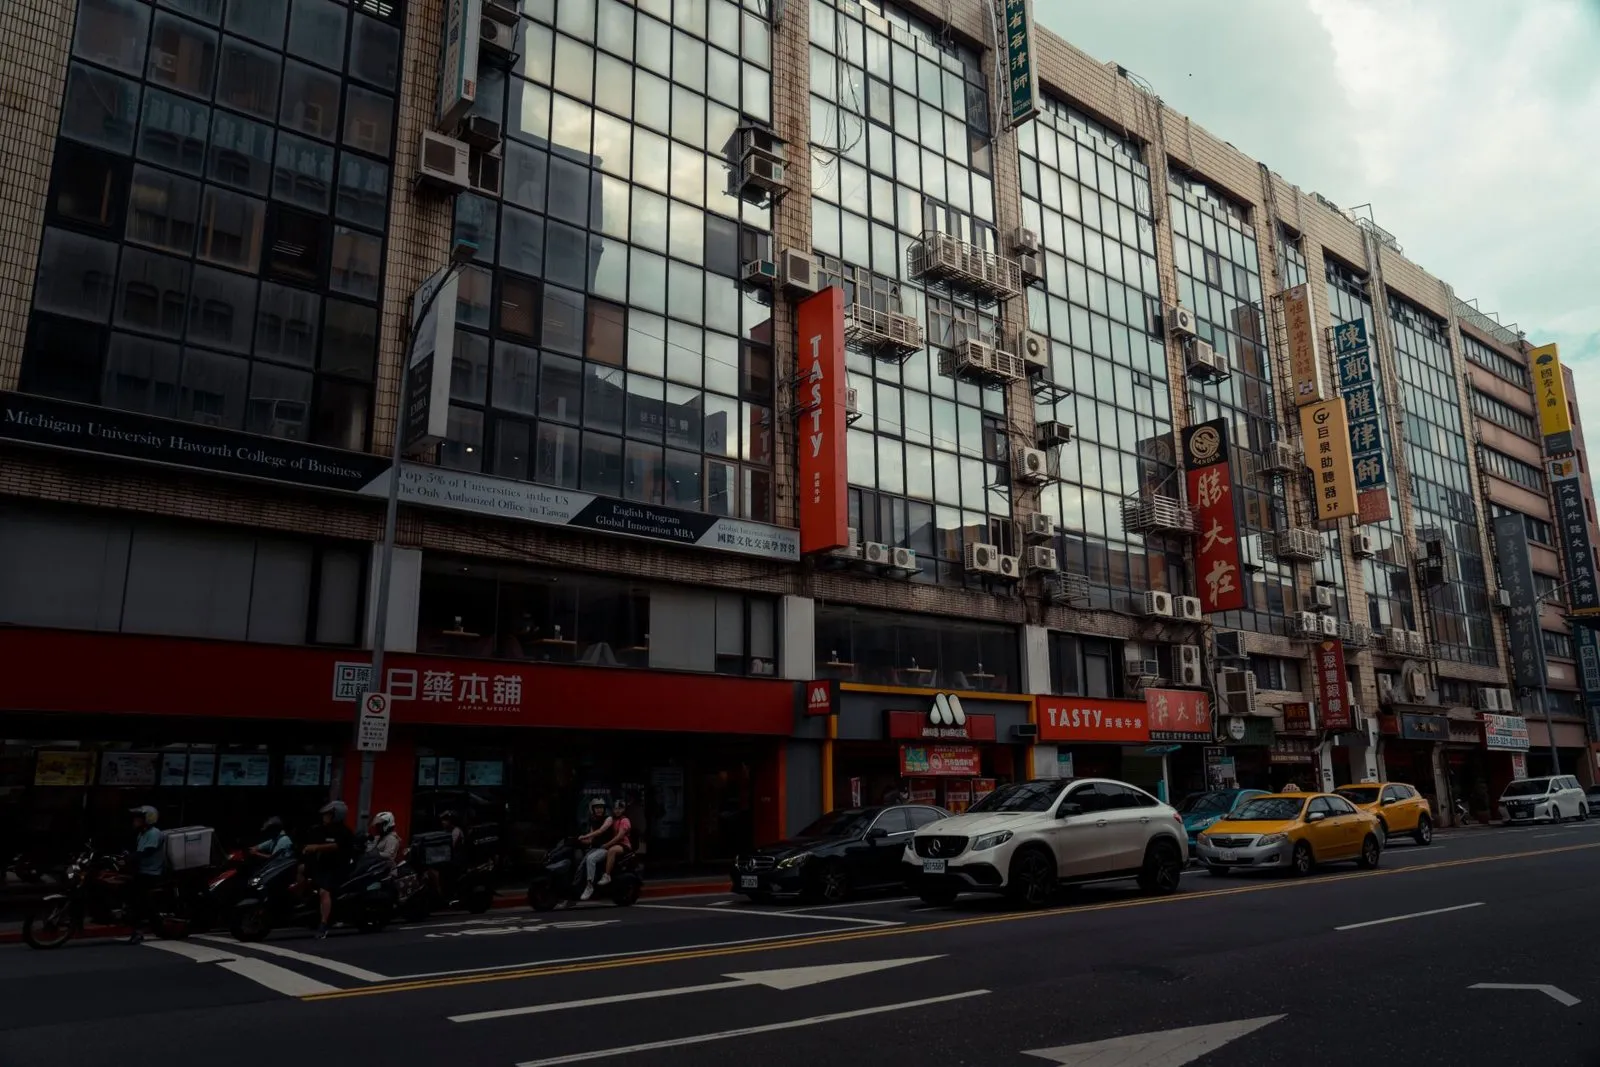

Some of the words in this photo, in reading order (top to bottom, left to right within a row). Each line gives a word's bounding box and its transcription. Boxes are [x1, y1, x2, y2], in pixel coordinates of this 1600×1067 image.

[808, 334, 823, 458] TASTY
[1337, 324, 1380, 484] 陳鄭權律師
[4, 408, 82, 433] Michigan
[87, 422, 165, 448] University
[170, 436, 233, 458] Haworth
[236, 447, 287, 468] College
[290, 456, 306, 470] of
[308, 459, 363, 479] Business
[1317, 426, 1337, 498] 巨泉助聽器
[417, 487, 442, 500] Only
[444, 492, 495, 508] Authorized
[498, 500, 524, 512] Office
[539, 506, 570, 518] Taiwan
[426, 472, 445, 486] 5%
[448, 479, 459, 489] of
[463, 480, 521, 498] Universities
[555, 494, 569, 506] US
[612, 504, 644, 520] English
[645, 512, 680, 526] Program
[1326, 503, 1339, 512] 5F
[595, 514, 626, 529] Global
[627, 518, 671, 536] Innovation
[673, 528, 696, 540] MBA
[386, 668, 524, 706] 日藥本舖
[457, 704, 483, 712] JAPAN
[486, 706, 521, 714] MEDICAL
[1047, 708, 1103, 728] TASTY
